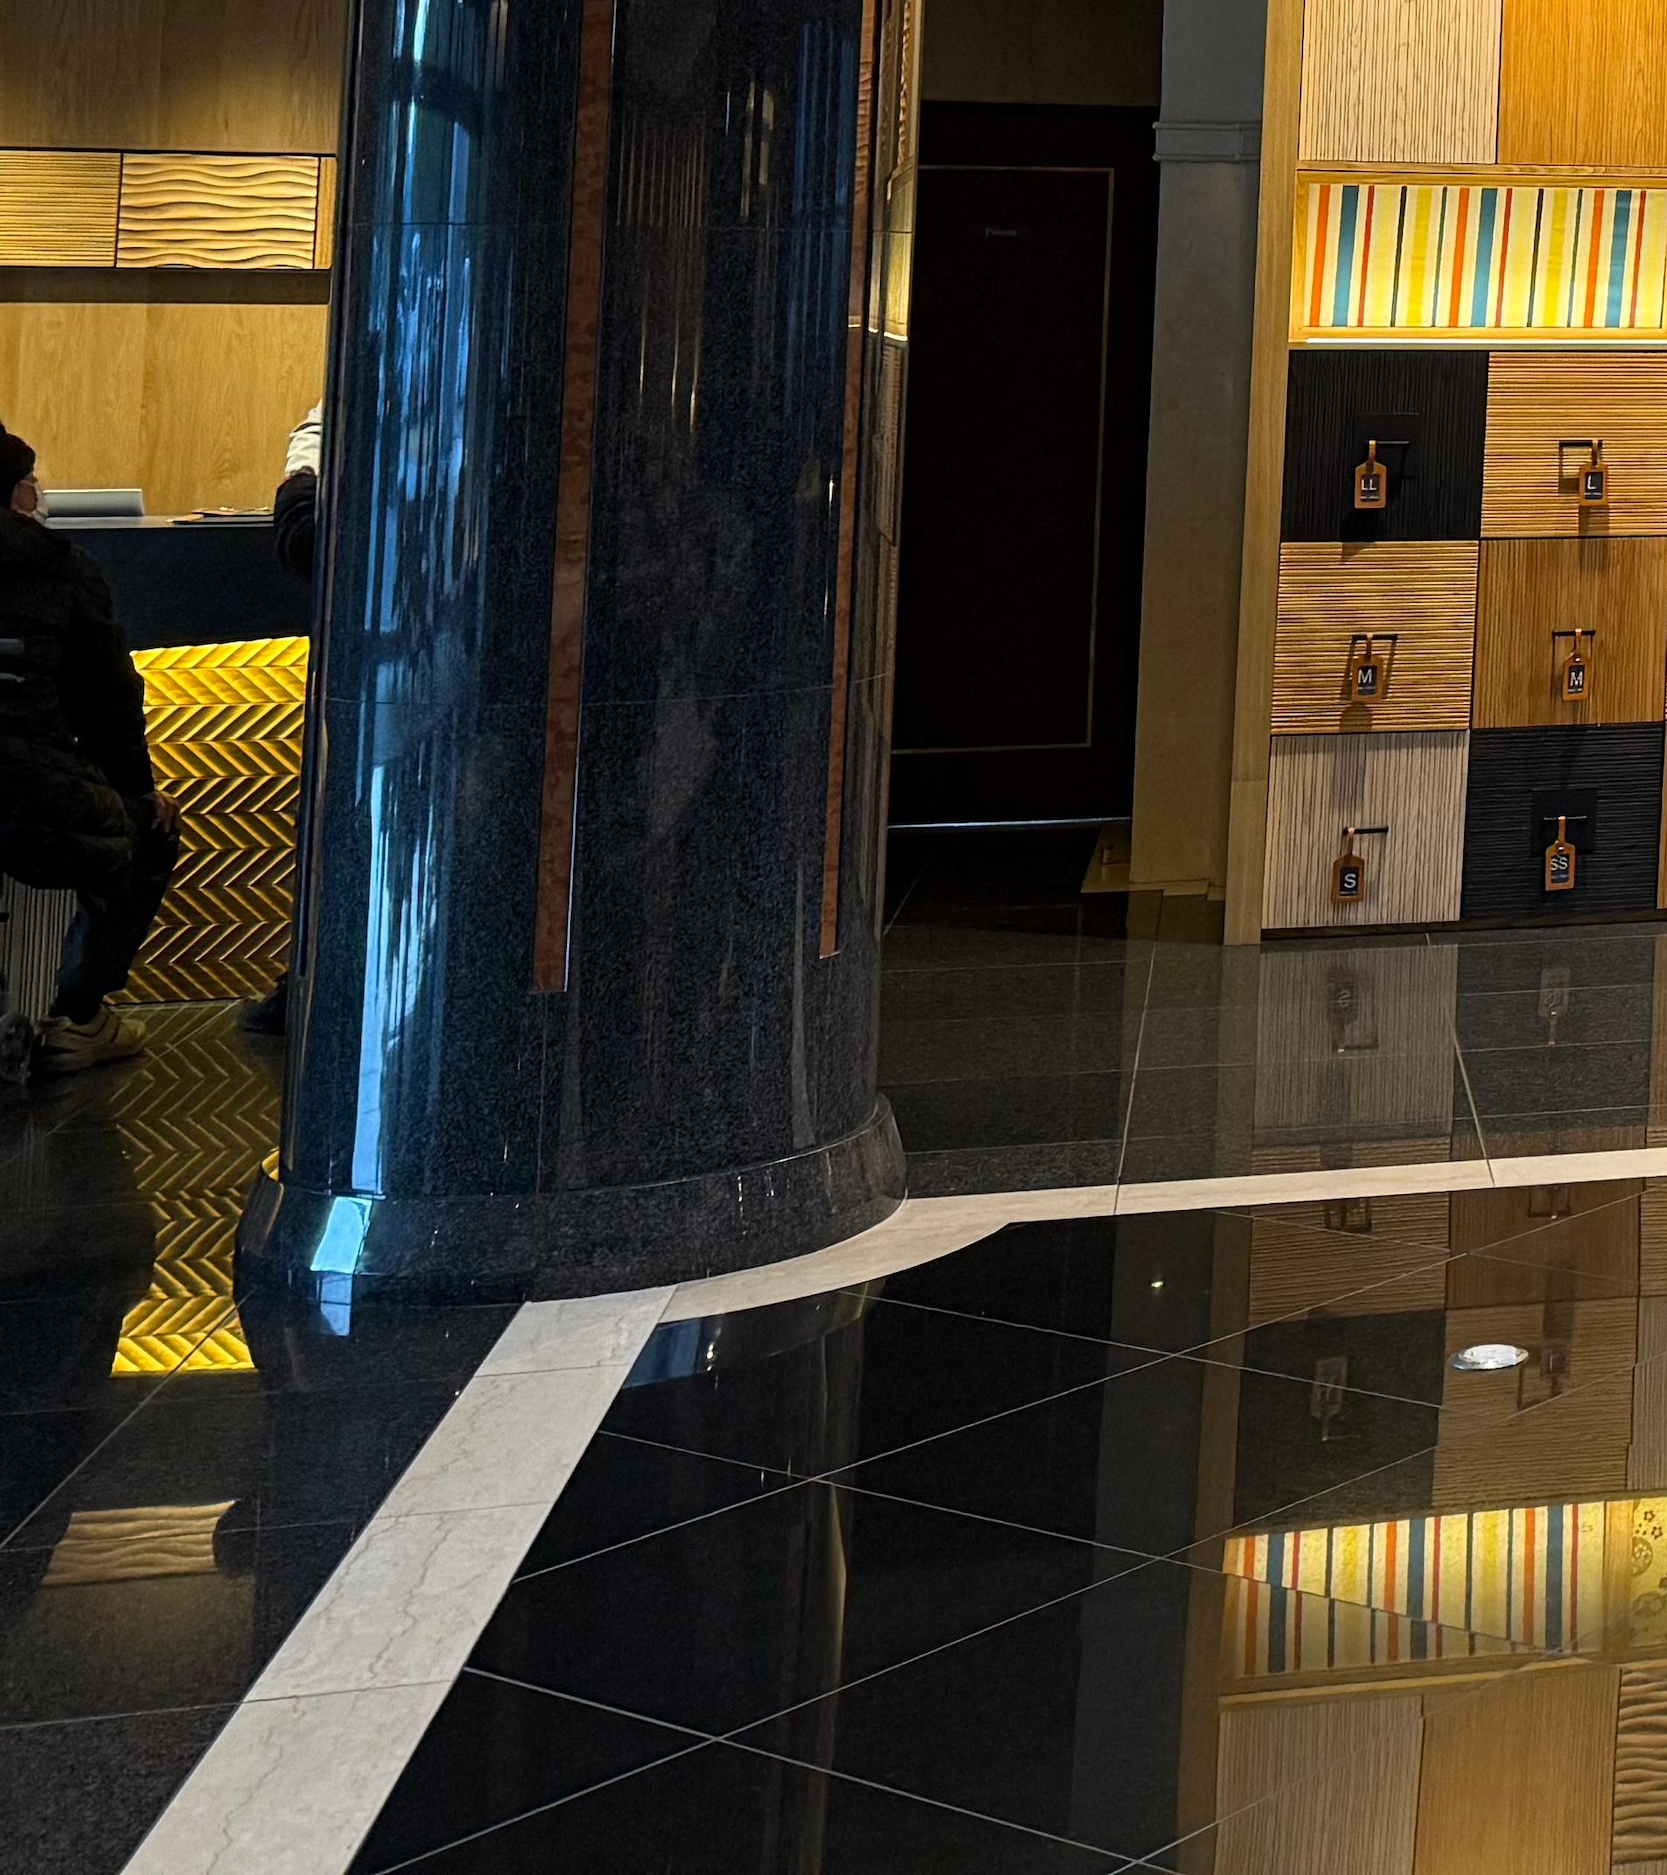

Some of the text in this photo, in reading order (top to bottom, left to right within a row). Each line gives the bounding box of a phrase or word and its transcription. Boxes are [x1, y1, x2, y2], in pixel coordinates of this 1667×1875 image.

[1362, 479, 1377, 490] LL
[1587, 475, 1596, 489] L
[1358, 669, 1372, 683] M
[1570, 671, 1582, 686] M
[1551, 857, 1568, 871] SS
[1344, 873, 1356, 888] S
